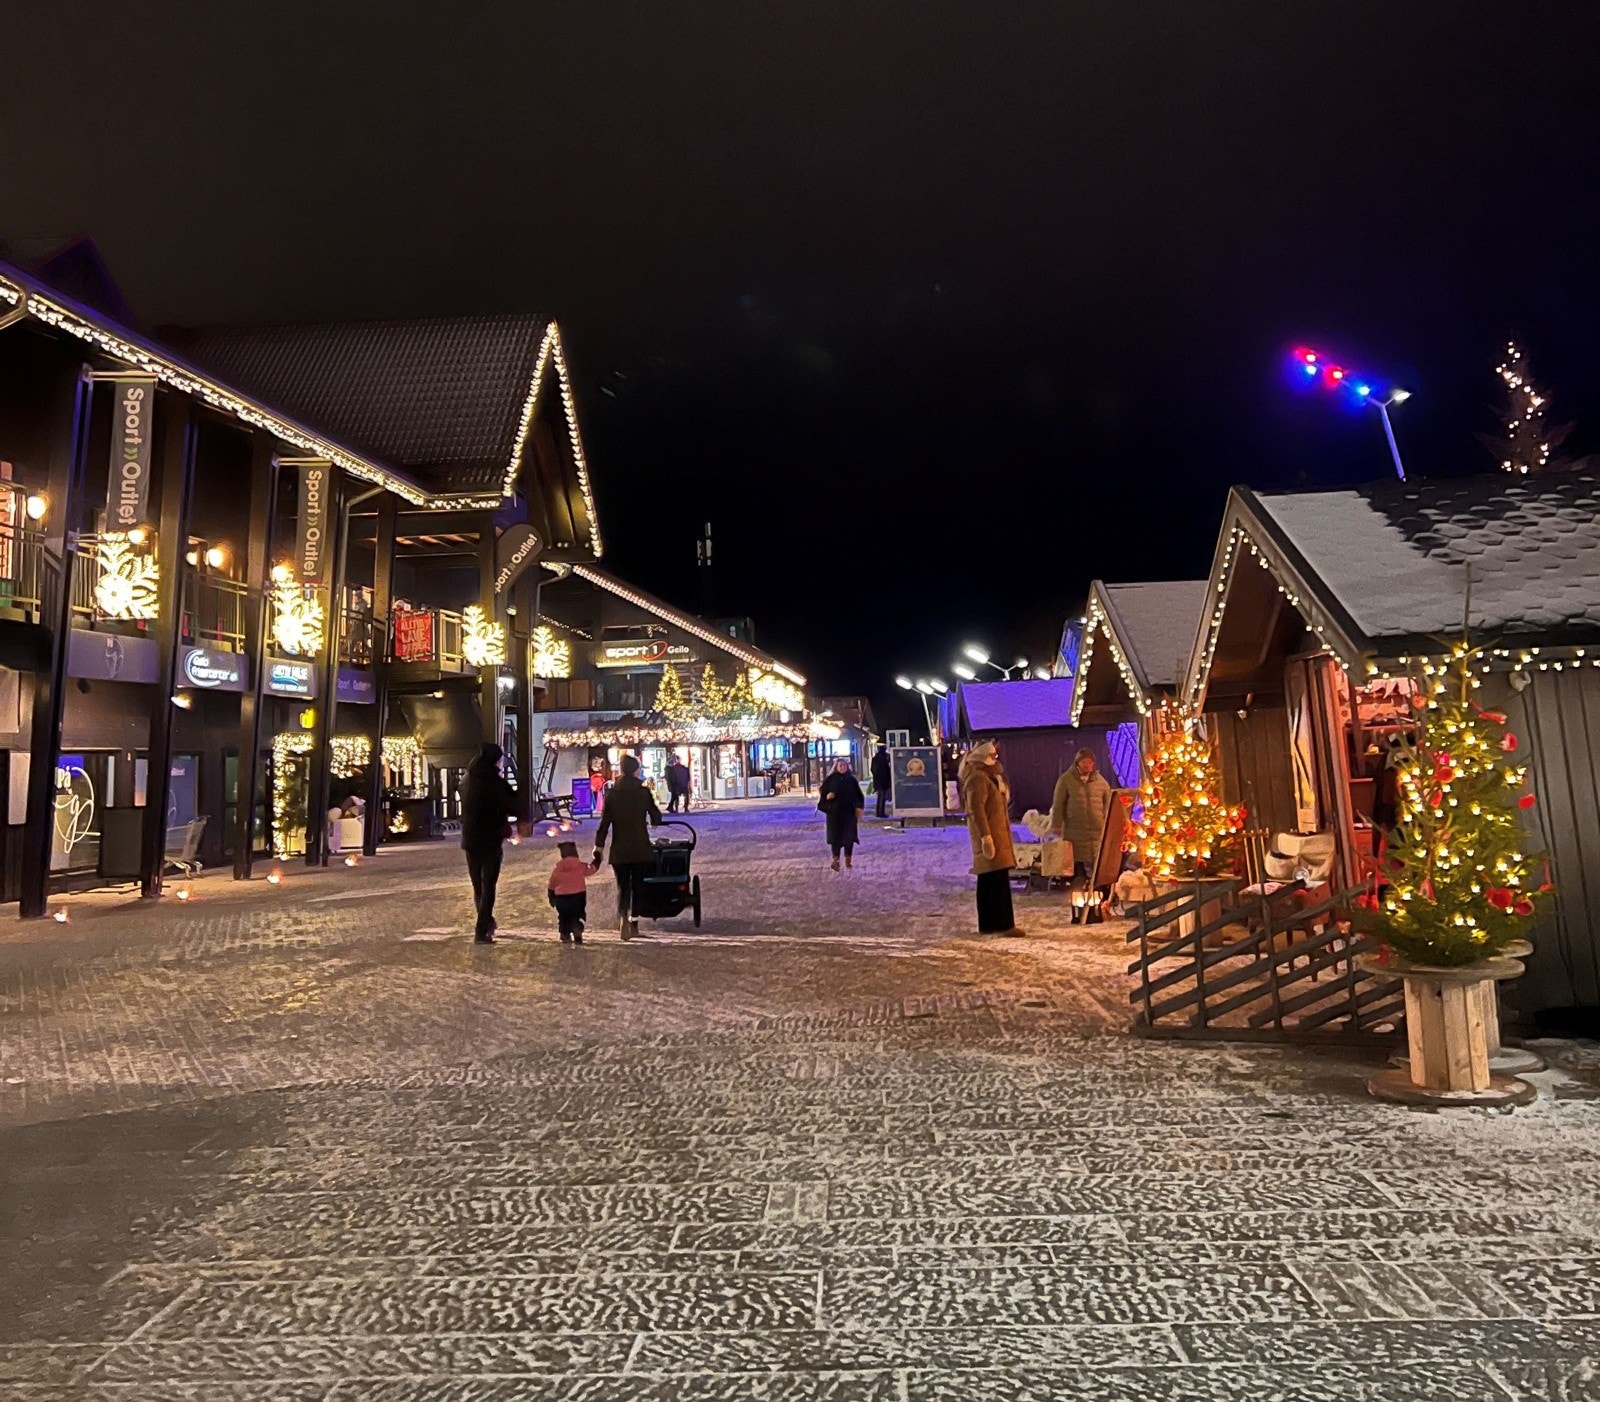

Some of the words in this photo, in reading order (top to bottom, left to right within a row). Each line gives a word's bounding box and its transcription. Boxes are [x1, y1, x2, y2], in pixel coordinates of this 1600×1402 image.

[123, 388, 144, 445] Sport
[118, 461, 141, 525] Outlet
[305, 470, 322, 515] Sport
[303, 527, 320, 576] Outlet
[495, 567, 511, 594] port
[511, 533, 538, 564] Outlet
[606, 645, 649, 658] sport
[667, 646, 689, 654] Geilo
